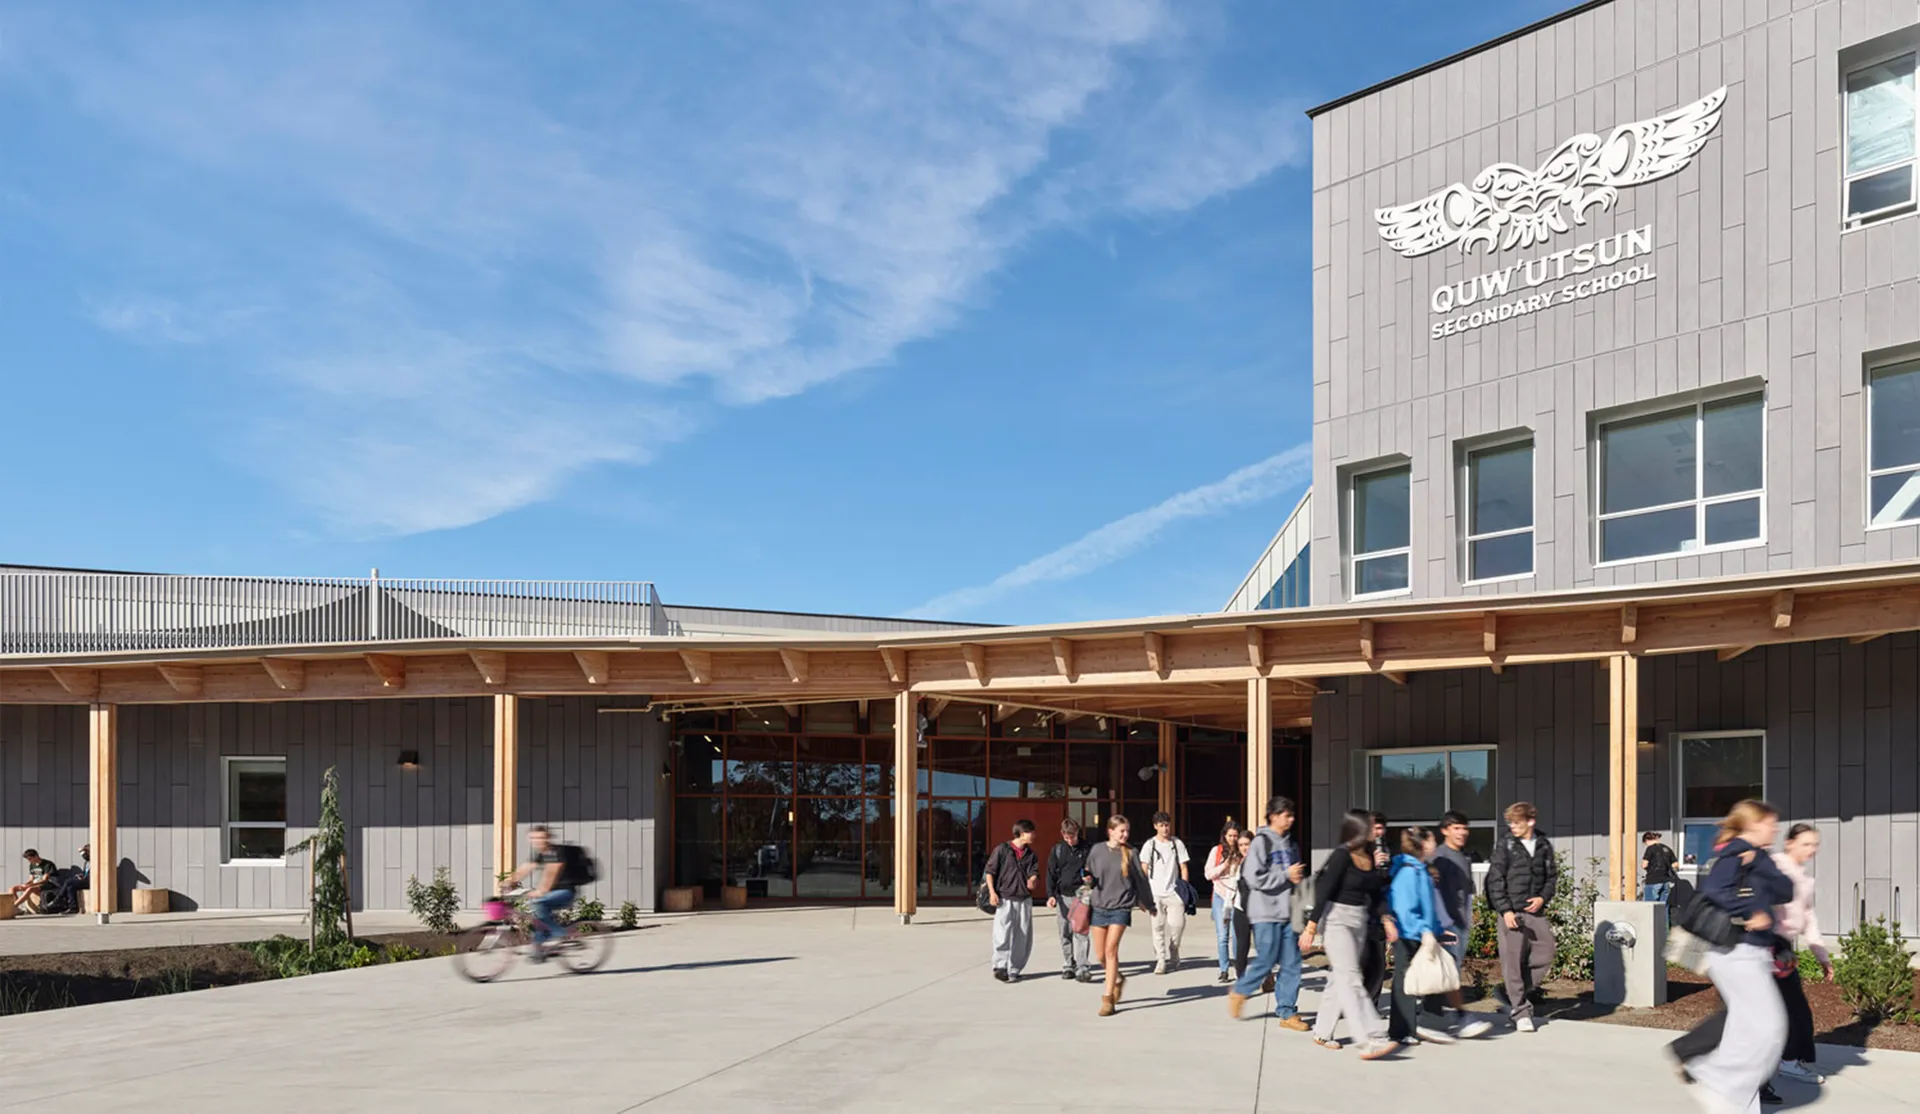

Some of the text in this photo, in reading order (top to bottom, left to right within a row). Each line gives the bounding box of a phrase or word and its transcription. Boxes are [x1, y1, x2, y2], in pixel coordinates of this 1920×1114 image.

[1431, 263, 1657, 339] SECONDARY SCHOOL
[1432, 224, 1652, 313] QUW'UTSUN
